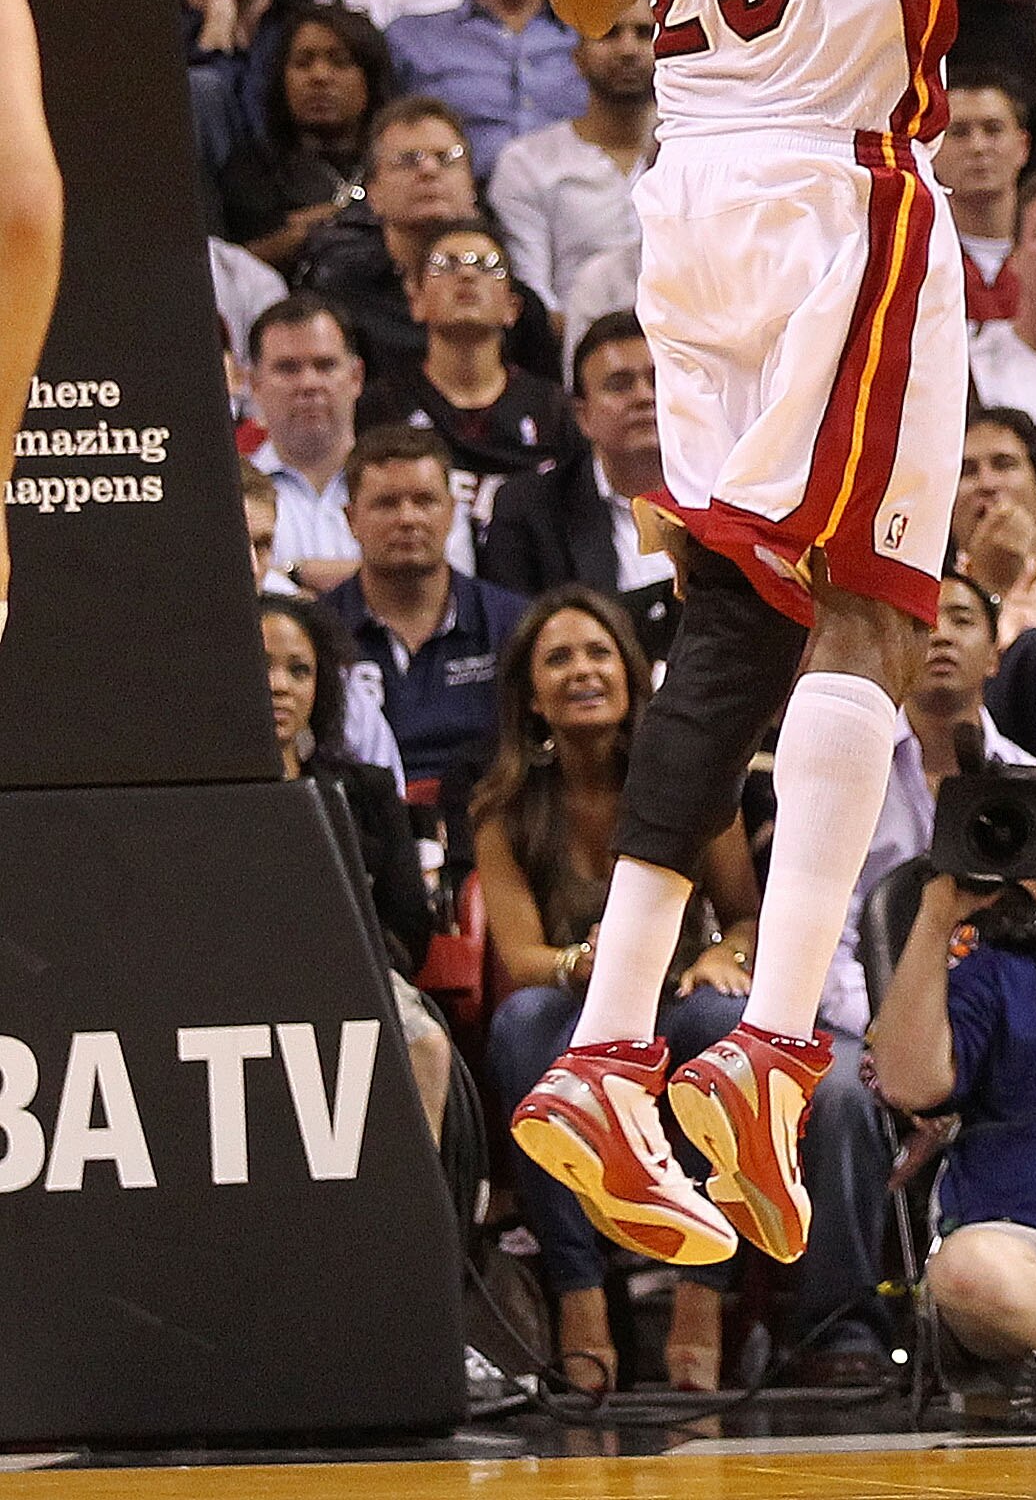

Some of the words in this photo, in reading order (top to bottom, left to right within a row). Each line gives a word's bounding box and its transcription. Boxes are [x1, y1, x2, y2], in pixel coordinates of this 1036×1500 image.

[28, 375, 121, 409] here
[14, 419, 170, 463] mazing
[0, 1030, 158, 1192] BA
[176, 1019, 381, 1185] TV
